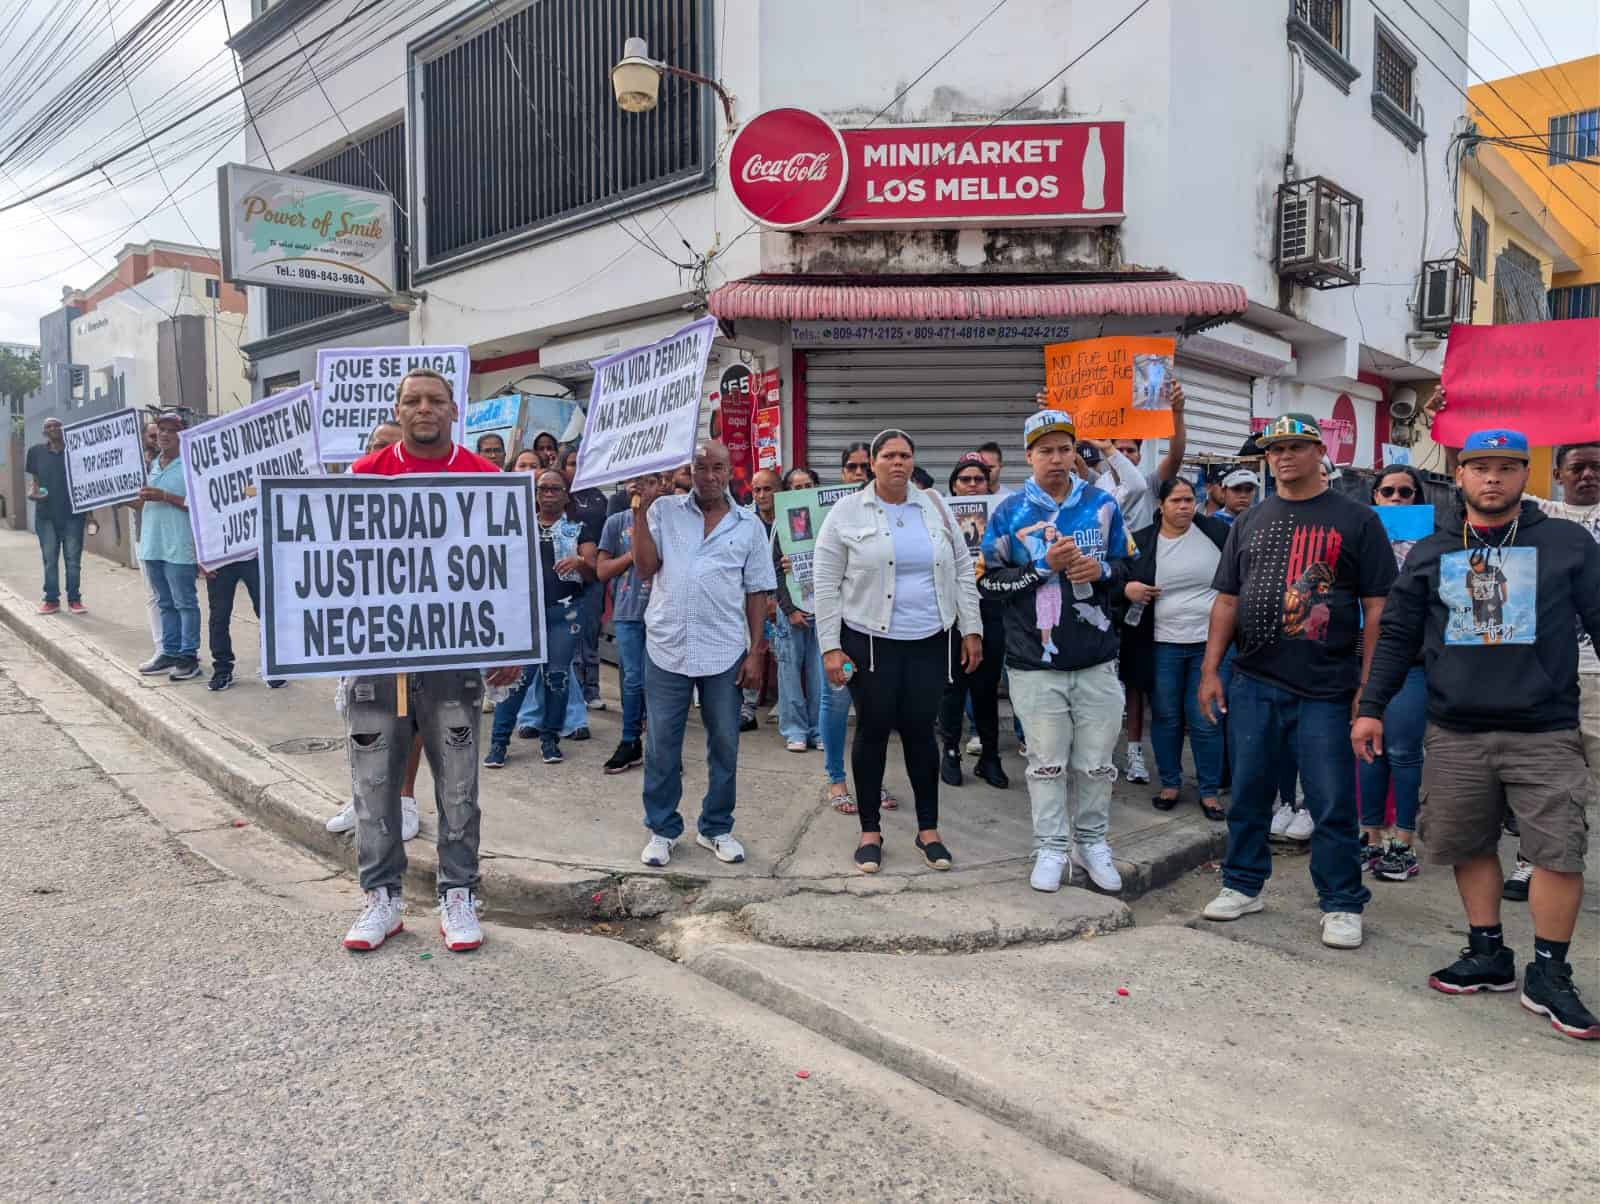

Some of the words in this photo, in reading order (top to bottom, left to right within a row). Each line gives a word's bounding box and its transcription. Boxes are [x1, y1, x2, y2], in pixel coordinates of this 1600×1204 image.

[742, 152, 830, 183] Coca-Cola
[864, 139, 1063, 167] MINIMARKET
[867, 180, 927, 203] LOS
[936, 175, 1059, 201] MELLOS
[242, 196, 306, 228] Power
[312, 210, 332, 238] of
[335, 212, 384, 239] Smile
[299, 268, 365, 285] 809-843-9634
[329, 358, 374, 382] ¡QUE
[379, 357, 402, 378] SE
[407, 355, 456, 374] HAGA
[601, 360, 625, 395] UNA
[628, 353, 651, 388] VIDA
[329, 382, 397, 403] JUSTIC
[615, 388, 659, 429] FAMILIA
[82, 422, 113, 447] ALZAMOS
[111, 418, 121, 440] LA
[120, 416, 136, 437] VOZ
[190, 434, 220, 477] QUE
[220, 422, 240, 464] SU
[239, 406, 294, 455] MUERTE
[292, 399, 312, 436] NO
[606, 423, 668, 471] ¡JUSTICIA!
[83, 454, 97, 473] POR
[96, 447, 124, 471] CHEIFRY
[113, 470, 142, 494] VARGAS
[275, 493, 316, 542] LA
[324, 492, 447, 542] VERDAD
[455, 491, 475, 538] Y
[485, 491, 523, 537] LA
[295, 546, 438, 600] JUSTICIA
[447, 543, 508, 592] SON
[303, 600, 505, 657] NECESARIAS.
